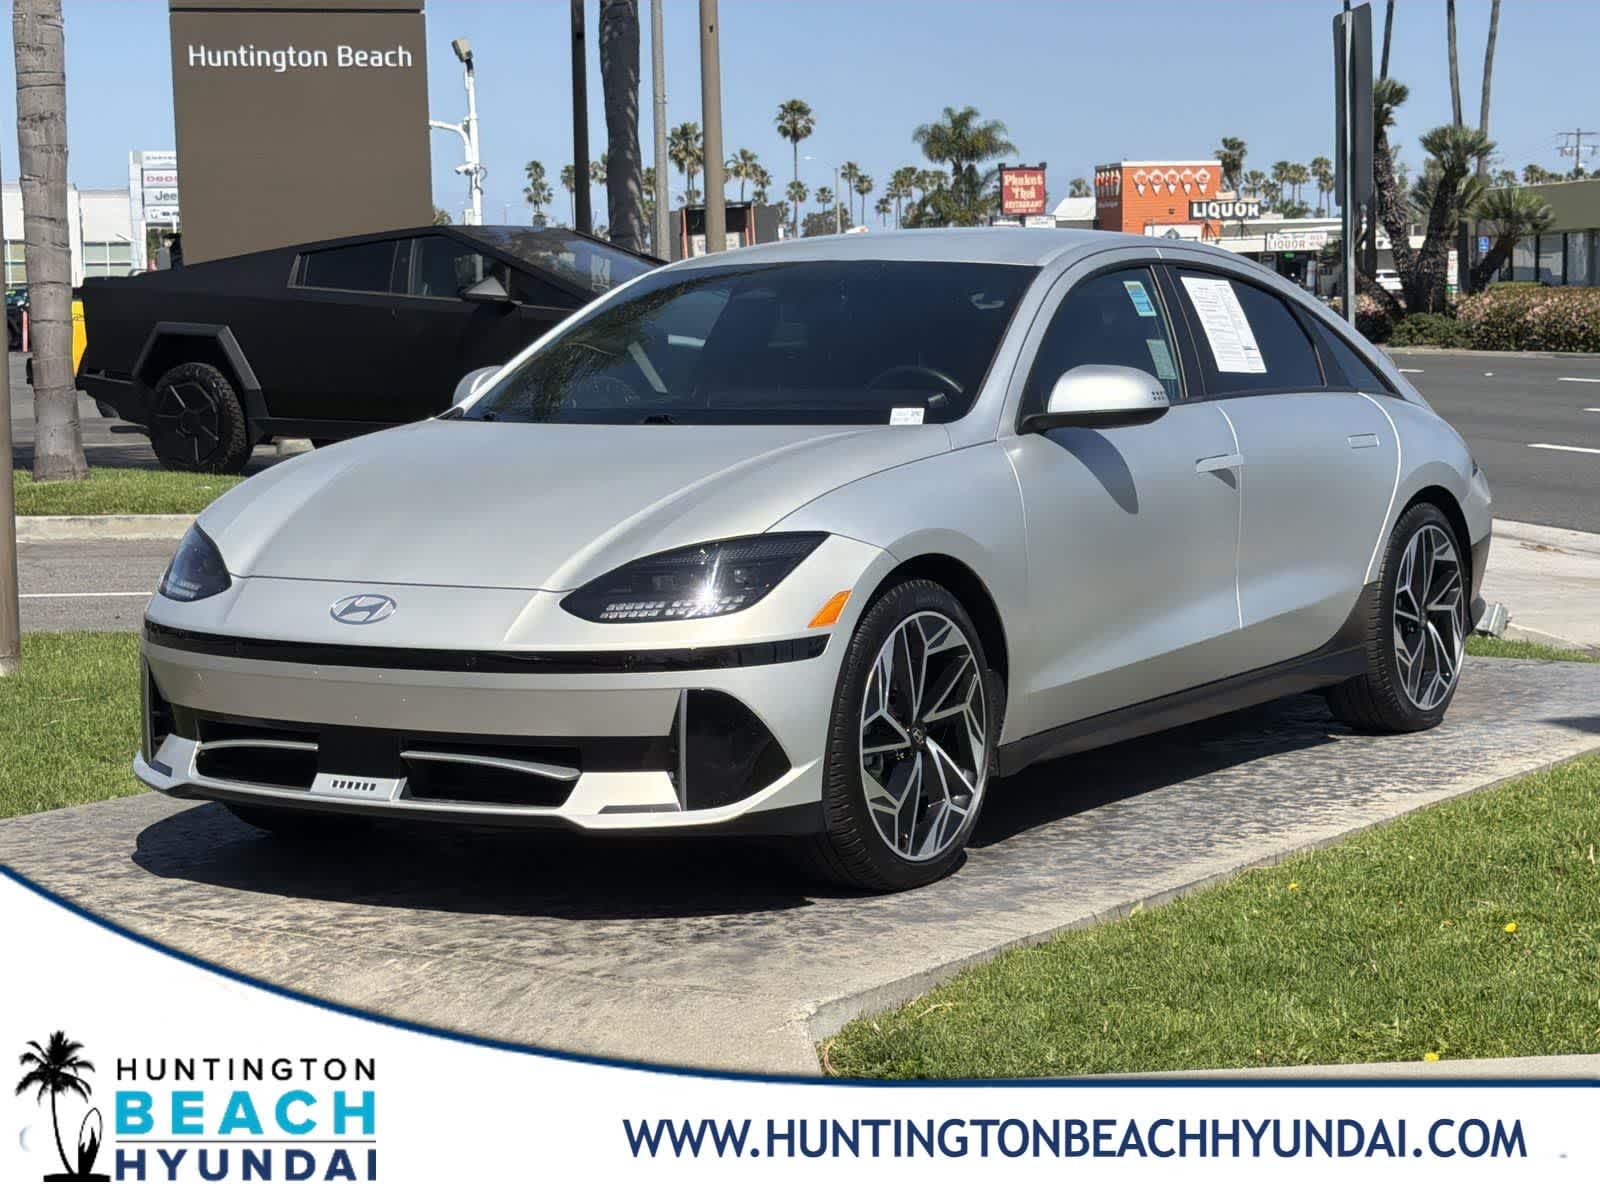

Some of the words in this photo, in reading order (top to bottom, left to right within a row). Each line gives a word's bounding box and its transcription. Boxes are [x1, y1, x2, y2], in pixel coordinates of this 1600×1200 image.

[188, 44, 328, 73] Huntington
[337, 45, 413, 67] Beach
[154, 190, 178, 201] Jee
[1192, 202, 1260, 219] LIQUOR
[1268, 239, 1306, 250] LIQUOR
